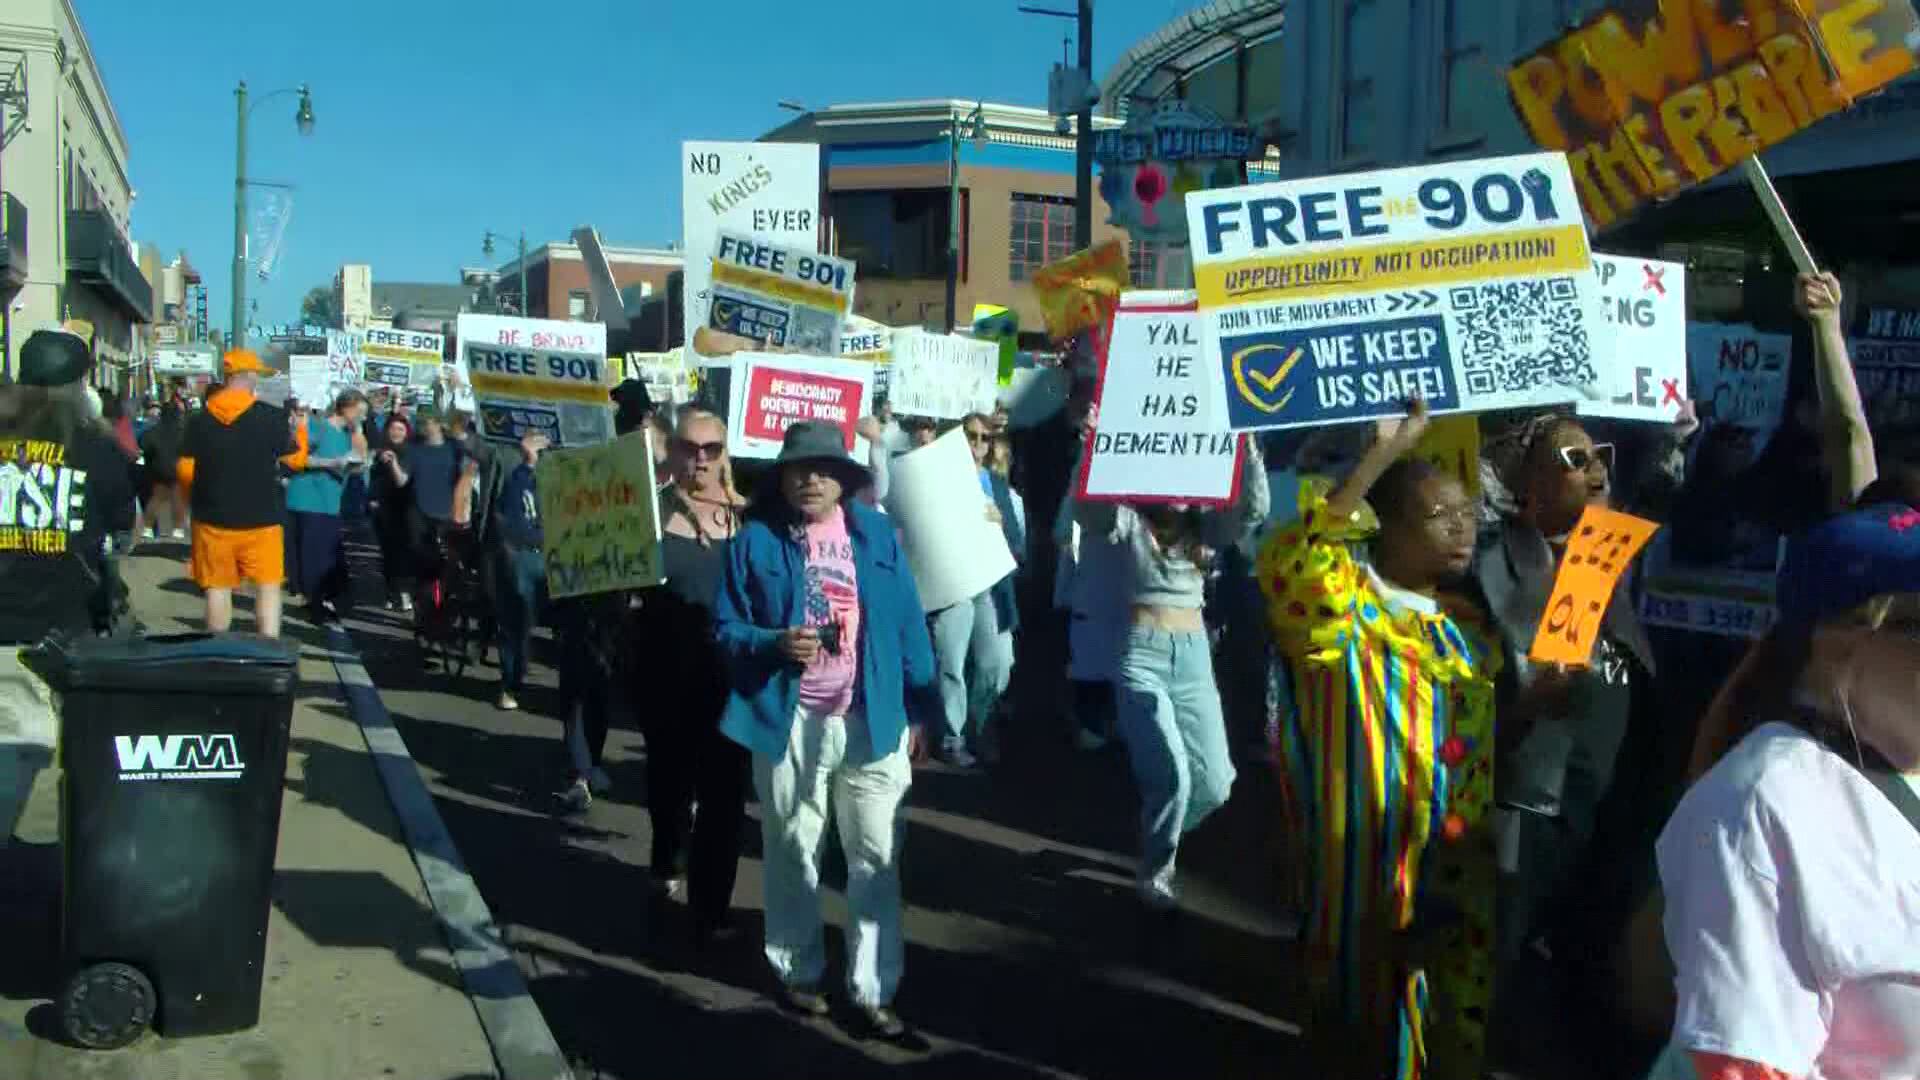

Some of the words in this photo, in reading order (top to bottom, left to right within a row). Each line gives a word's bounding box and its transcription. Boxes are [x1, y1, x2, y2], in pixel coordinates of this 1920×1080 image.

[690, 152, 721, 175] NO
[753, 208, 812, 232] EVER
[1203, 186, 1390, 254] FREE
[718, 235, 787, 274] FREE
[1375, 252, 1412, 273] NOT
[1420, 237, 1556, 269] OCCUPATION!
[1219, 311, 1251, 330] JOIN
[1256, 305, 1286, 326] THE
[1288, 297, 1377, 323] MOVEMENT
[367, 329, 406, 347] FREE
[1309, 335, 1359, 369] WE
[1362, 326, 1437, 364] KEEP
[470, 349, 537, 375] FREE
[1156, 356, 1193, 378] HE
[1316, 374, 1357, 408] US
[1361, 365, 1447, 404] SAFE!
[812, 400, 847, 423] WORK
[1142, 394, 1199, 417] HAS
[1094, 432, 1234, 457] DEMENTIA
[114, 734, 246, 770] WM
